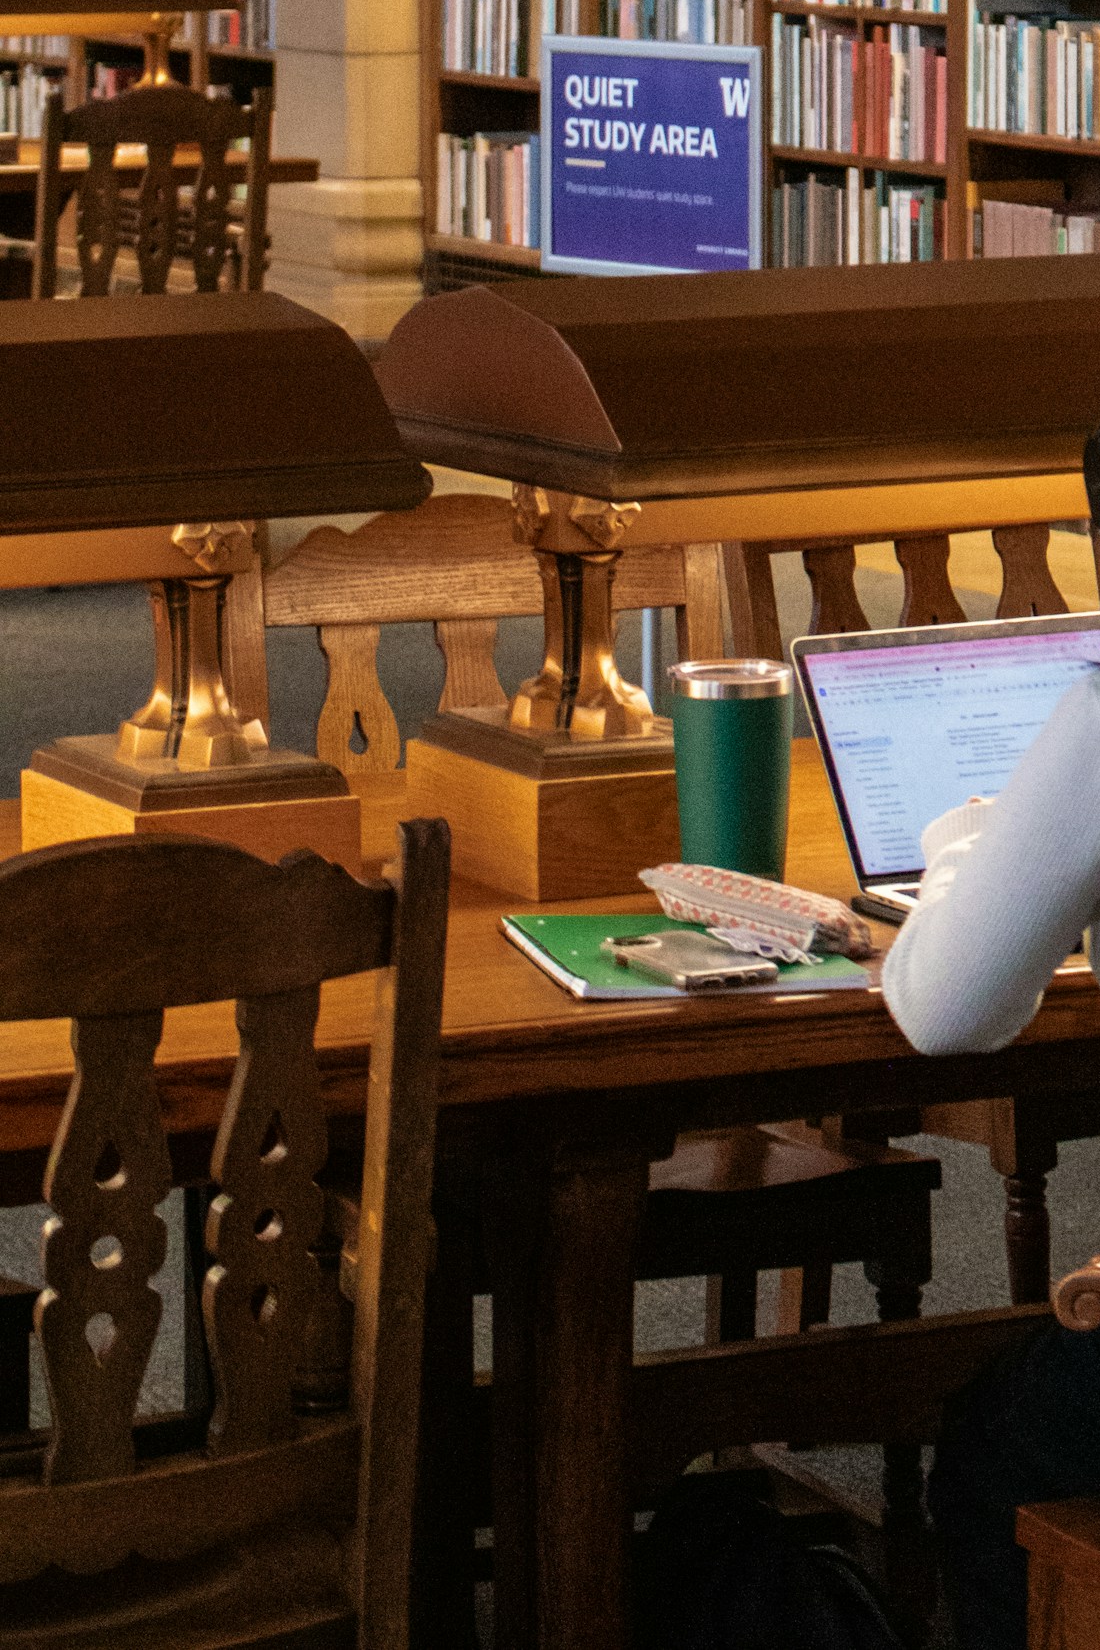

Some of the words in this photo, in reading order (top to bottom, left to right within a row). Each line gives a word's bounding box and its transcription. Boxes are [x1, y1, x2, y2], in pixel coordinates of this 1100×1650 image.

[564, 75, 639, 110] QUIET
[719, 77, 749, 118] W
[564, 117, 646, 153] STUDY
[650, 124, 718, 158] AREA
